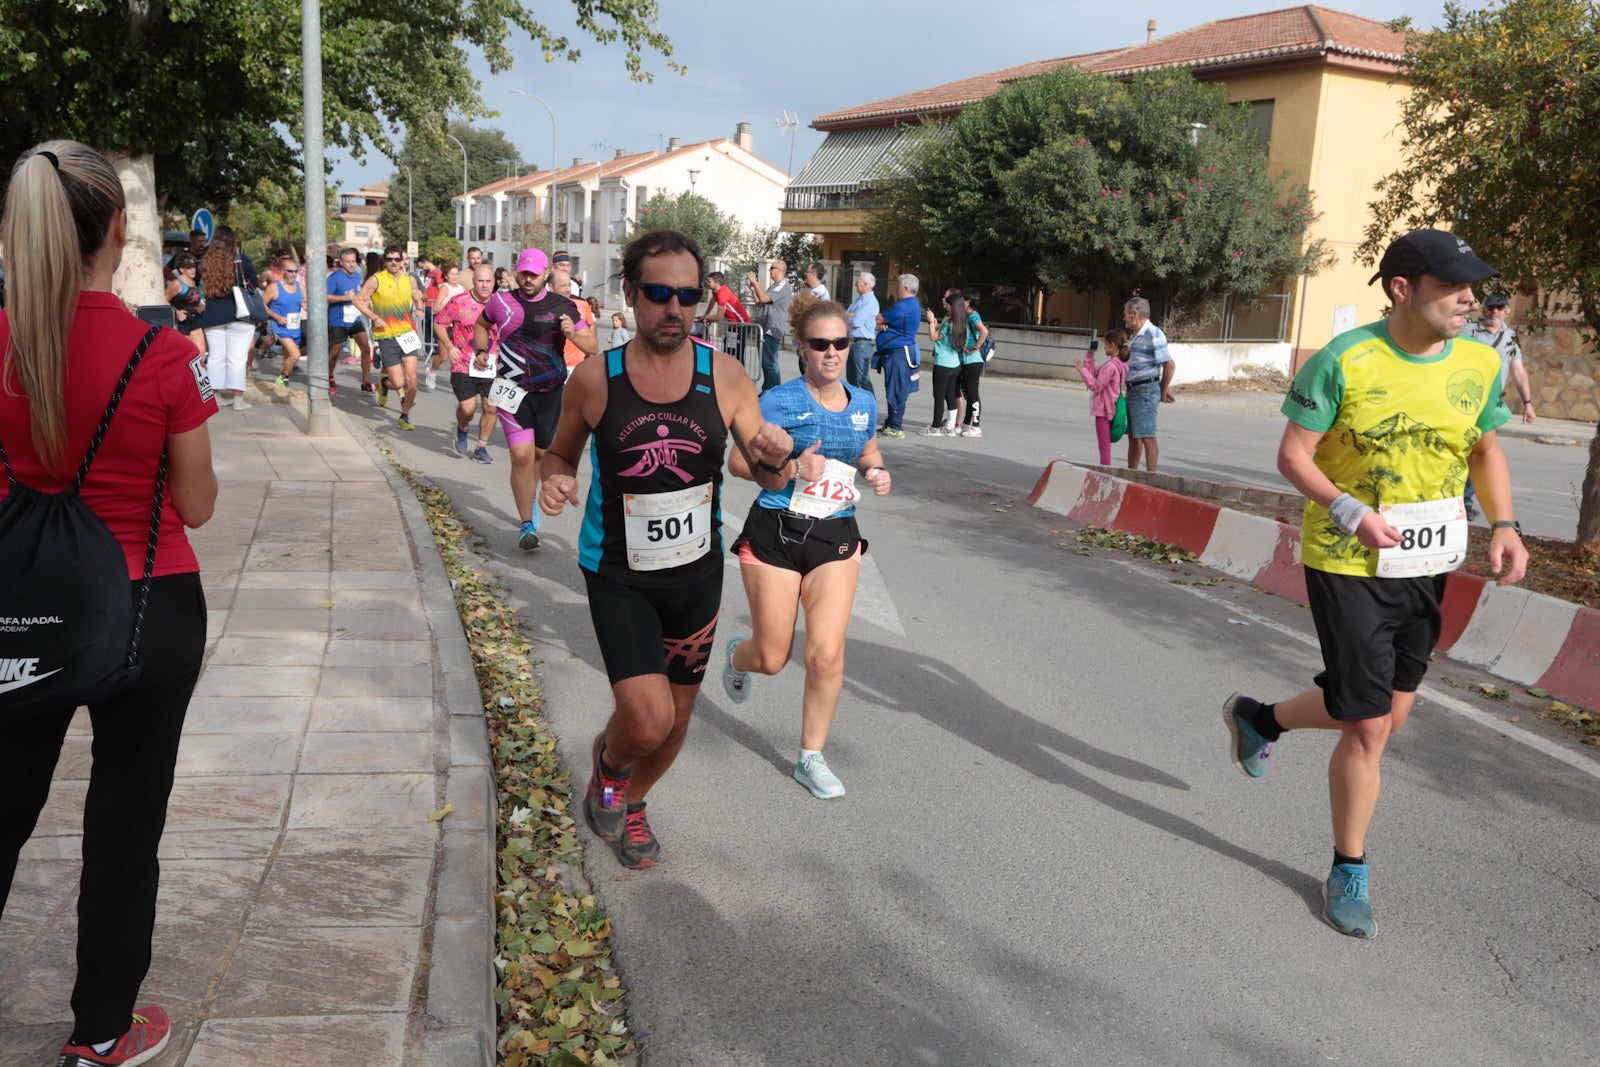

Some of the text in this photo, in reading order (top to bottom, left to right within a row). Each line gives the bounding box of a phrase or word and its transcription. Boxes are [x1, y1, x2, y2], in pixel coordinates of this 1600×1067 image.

[495, 385, 516, 399] 379
[618, 412, 656, 443] ATLETISMO
[657, 412, 689, 426] CULLAR
[647, 512, 693, 542] 501
[1400, 525, 1446, 550] 801
[21, 615, 64, 625] NADAL
